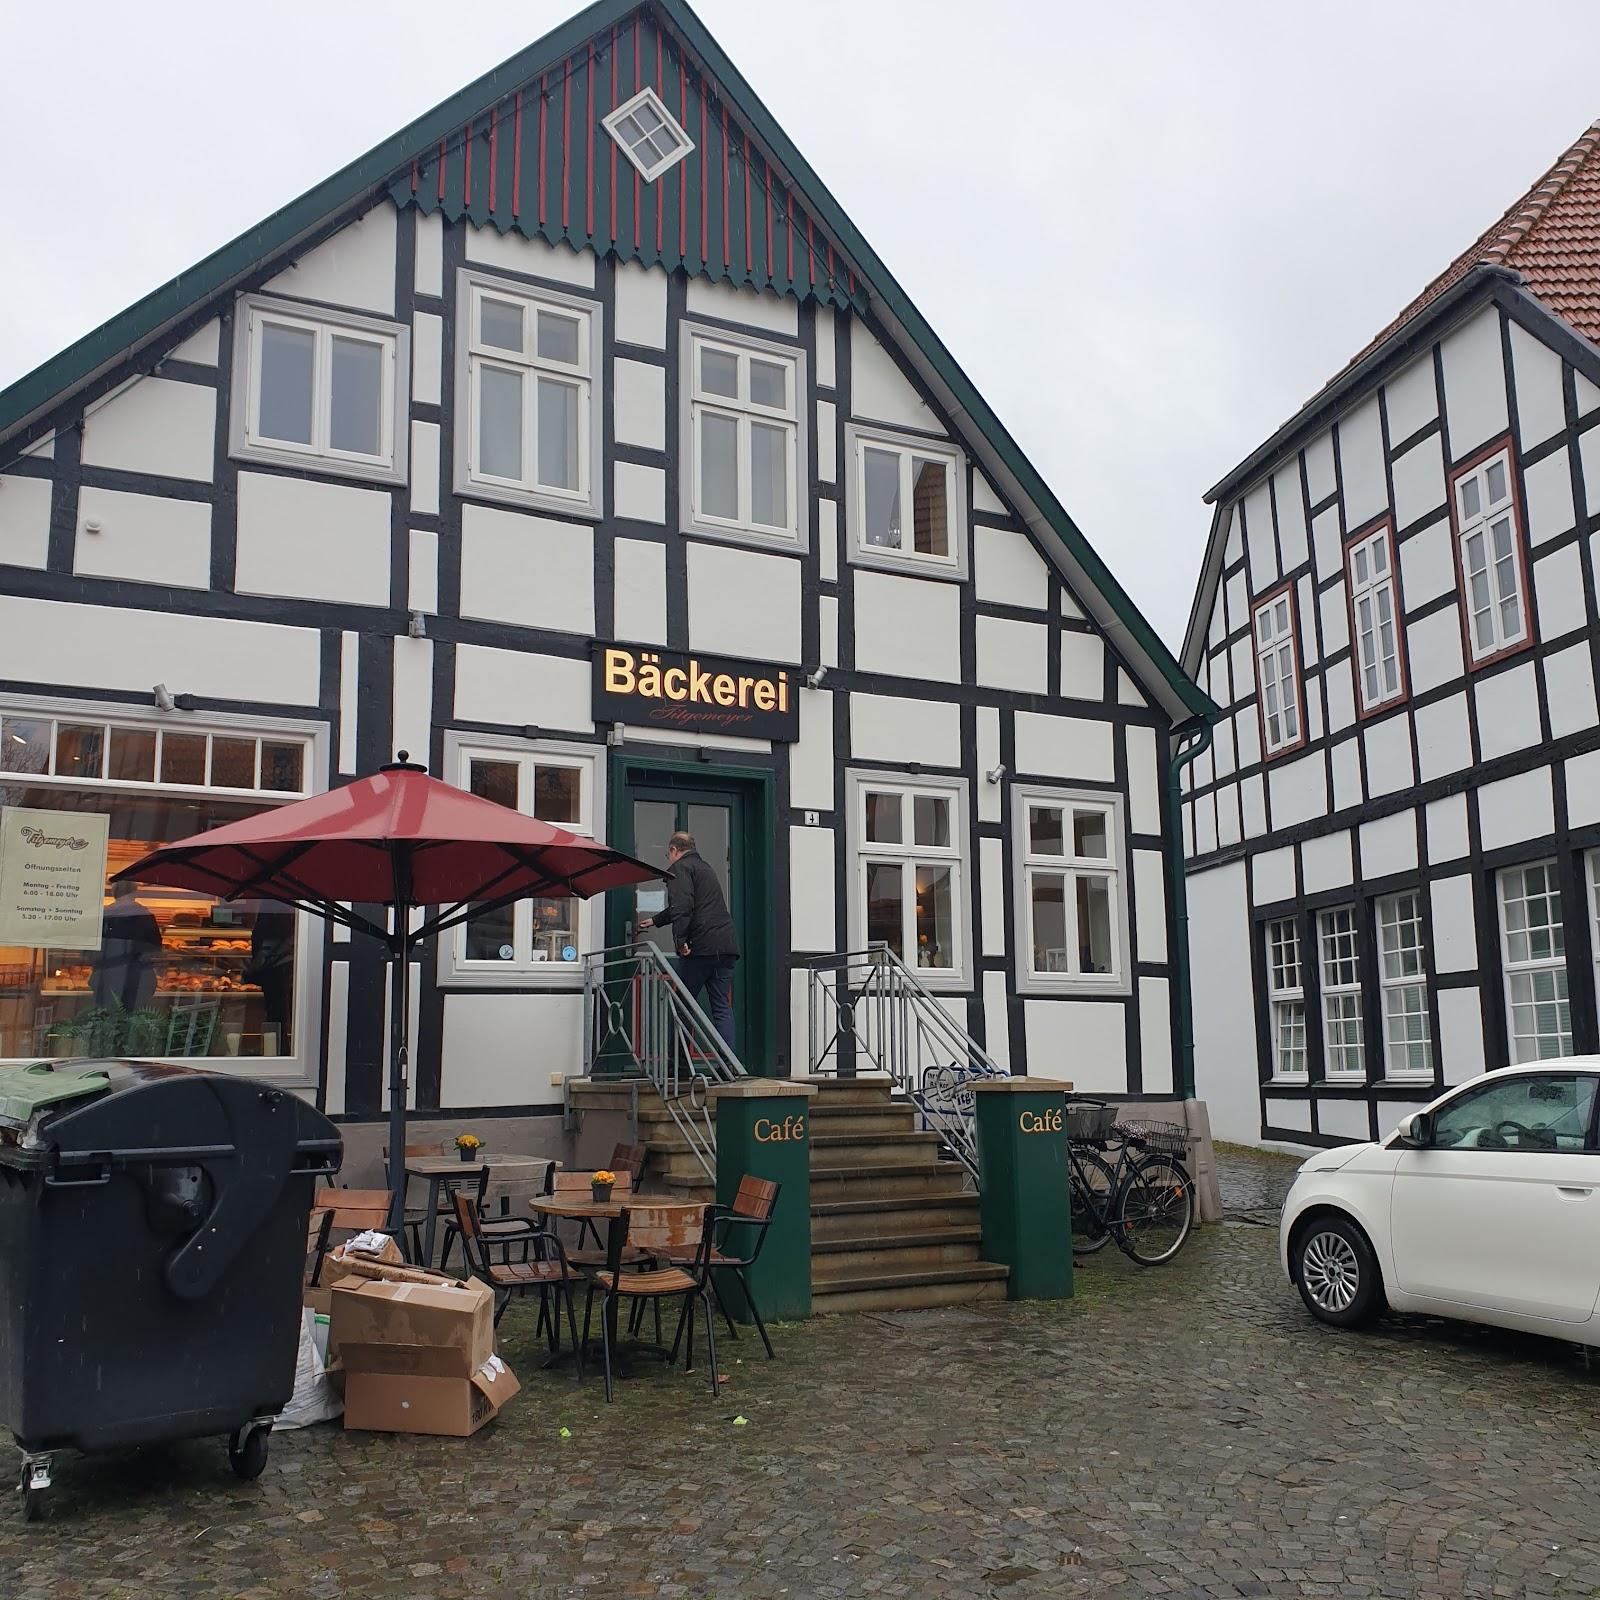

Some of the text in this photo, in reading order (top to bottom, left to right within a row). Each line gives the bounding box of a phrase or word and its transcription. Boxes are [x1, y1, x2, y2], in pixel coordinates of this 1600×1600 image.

[605, 648, 789, 712] Bäckerei
[808, 812, 815, 824] 4
[23, 881, 49, 889] Montag
[56, 883, 80, 891] Freitag
[16, 905, 46, 913] Samstag
[55, 907, 83, 915] Sonntag
[754, 1115, 804, 1142] Café
[1020, 1109, 1063, 1134] Café
